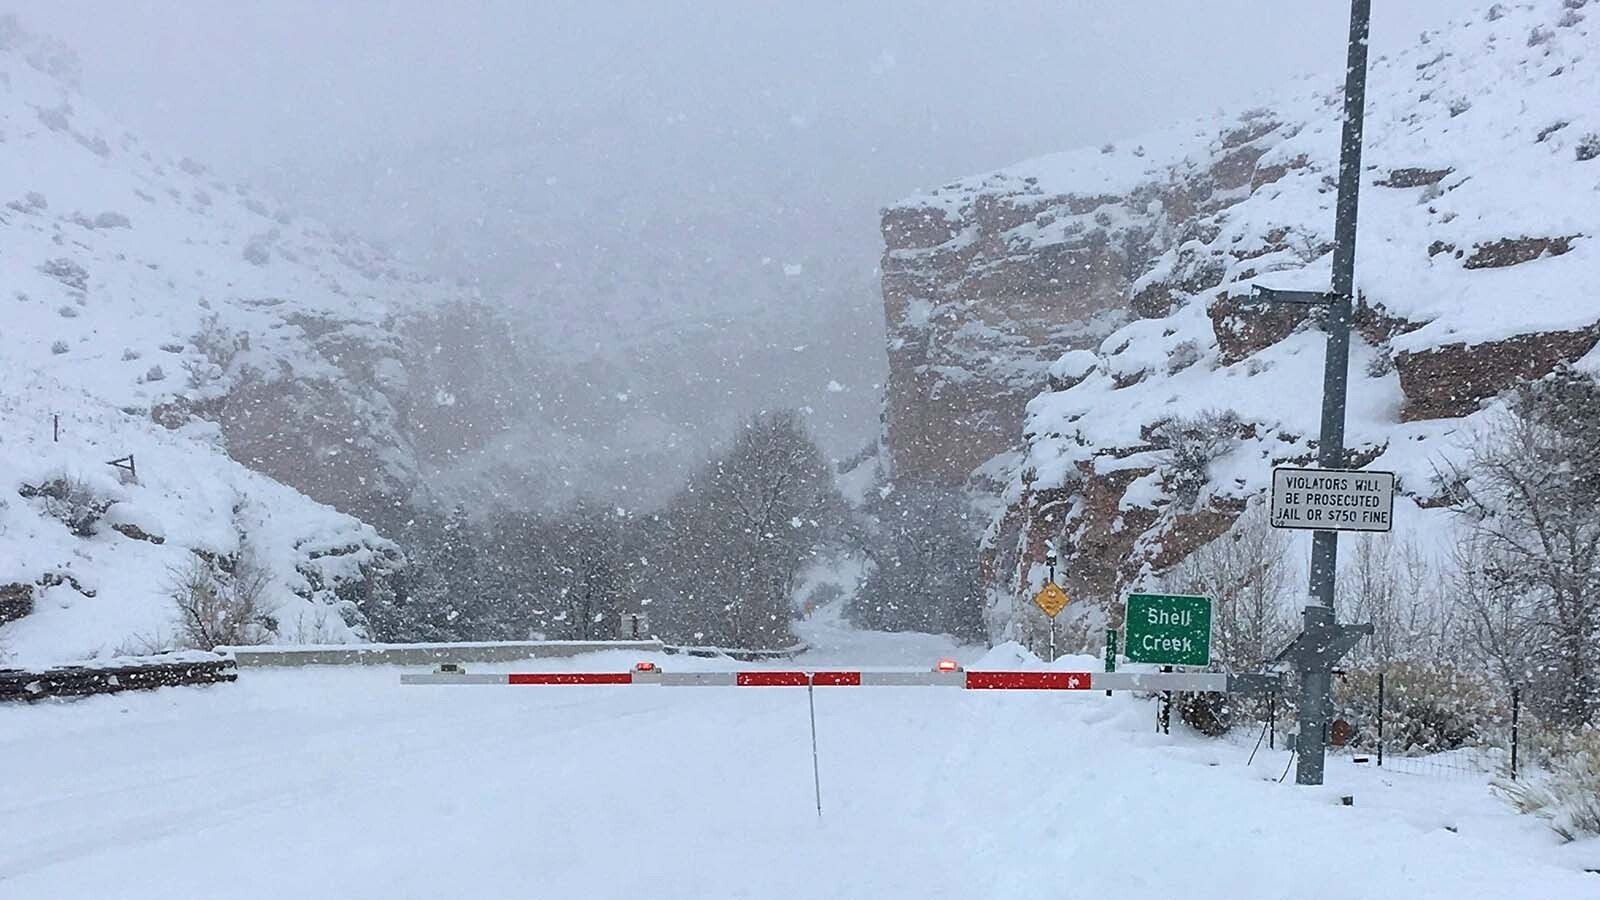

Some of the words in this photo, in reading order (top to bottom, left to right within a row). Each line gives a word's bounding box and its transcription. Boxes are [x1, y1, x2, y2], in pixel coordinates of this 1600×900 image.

[1286, 477, 1348, 490] VIOLATORS
[1355, 479, 1381, 492] WILL
[1285, 493, 1300, 505] BE
[1306, 493, 1380, 507] PROSECUTED
[1276, 507, 1300, 520] JAIL
[1307, 509, 1322, 521] OR
[1328, 510, 1357, 522] $750
[1362, 511, 1388, 523] FINE
[1148, 608, 1191, 627] Shell
[1142, 634, 1192, 652] Creek
